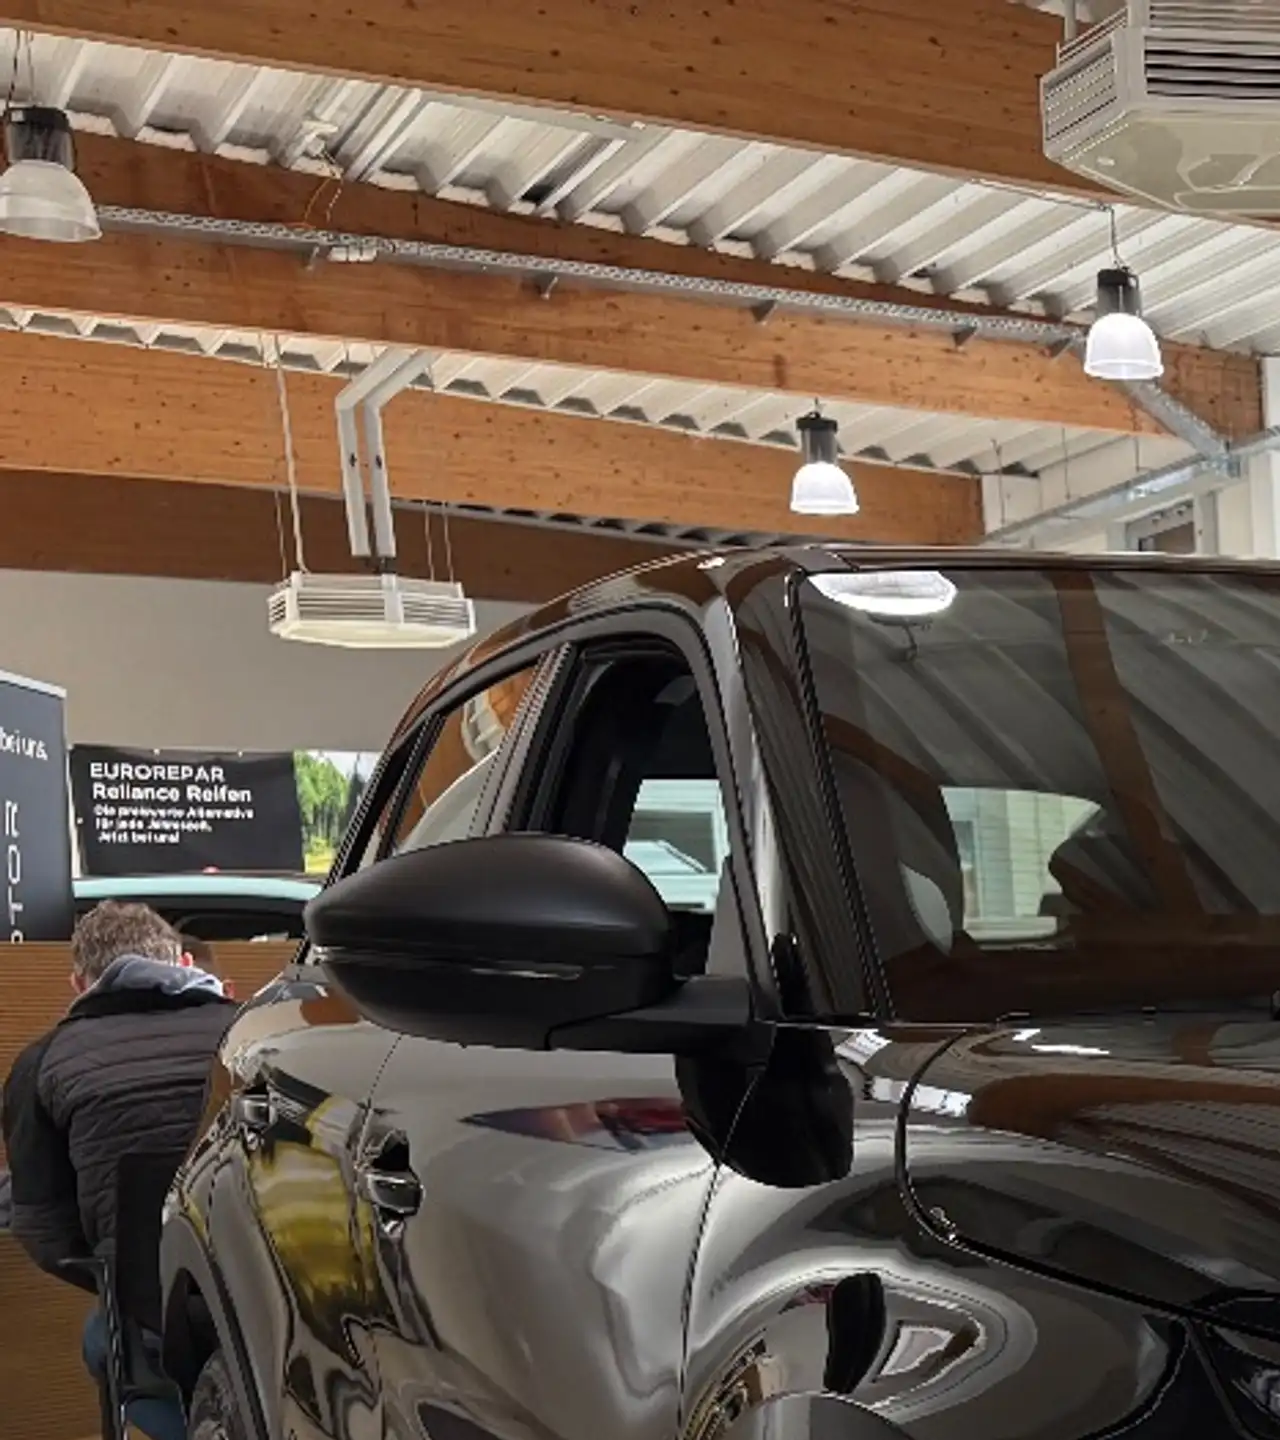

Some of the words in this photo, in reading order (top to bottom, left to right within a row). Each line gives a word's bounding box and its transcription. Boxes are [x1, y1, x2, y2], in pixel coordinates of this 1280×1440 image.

[90, 762, 225, 782] EUROREPAR
[93, 782, 180, 801] Reliance
[186, 784, 252, 802] Reifen
